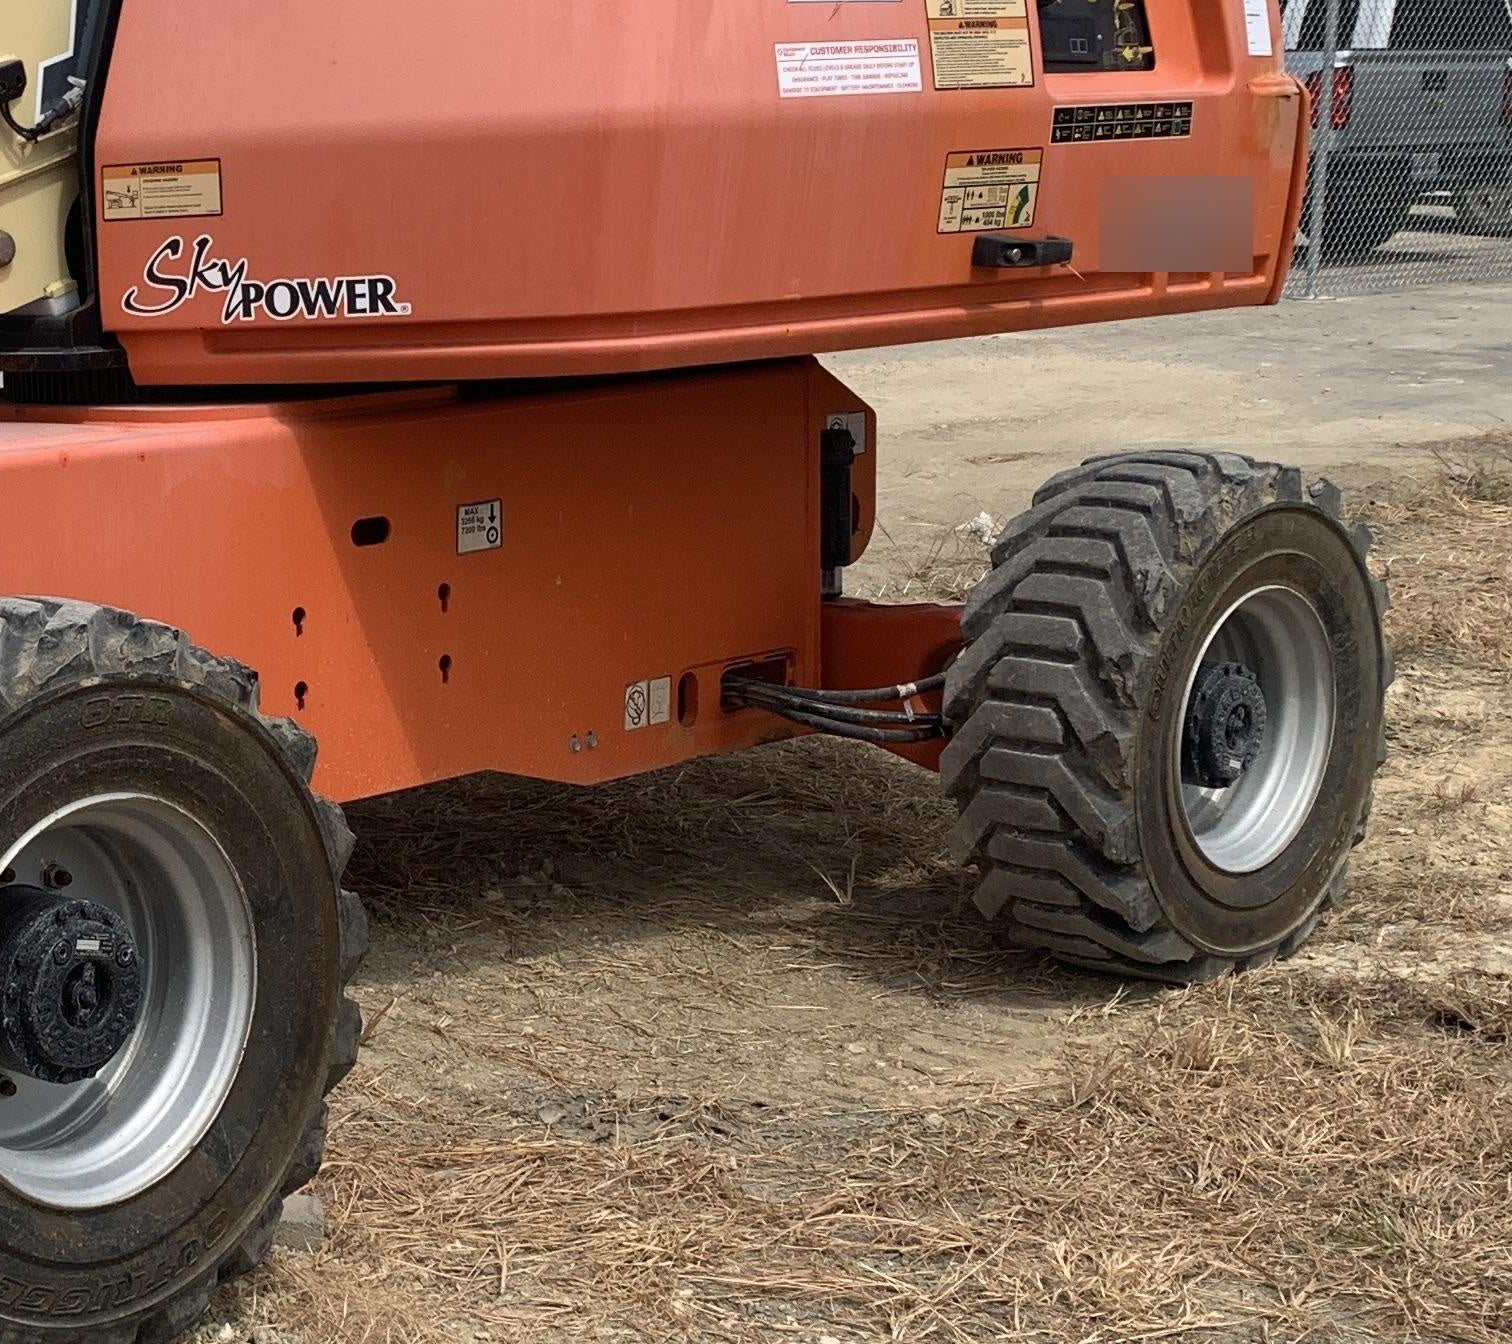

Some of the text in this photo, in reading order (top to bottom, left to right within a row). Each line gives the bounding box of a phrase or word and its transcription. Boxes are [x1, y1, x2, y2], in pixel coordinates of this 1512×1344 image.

[810, 43, 917, 56] CUSTOMER RESPONSIBILITY
[976, 152, 1023, 166] WARNING
[139, 164, 184, 175] WARNING
[464, 507, 479, 516] MAX
[81, 694, 175, 729] OTR
